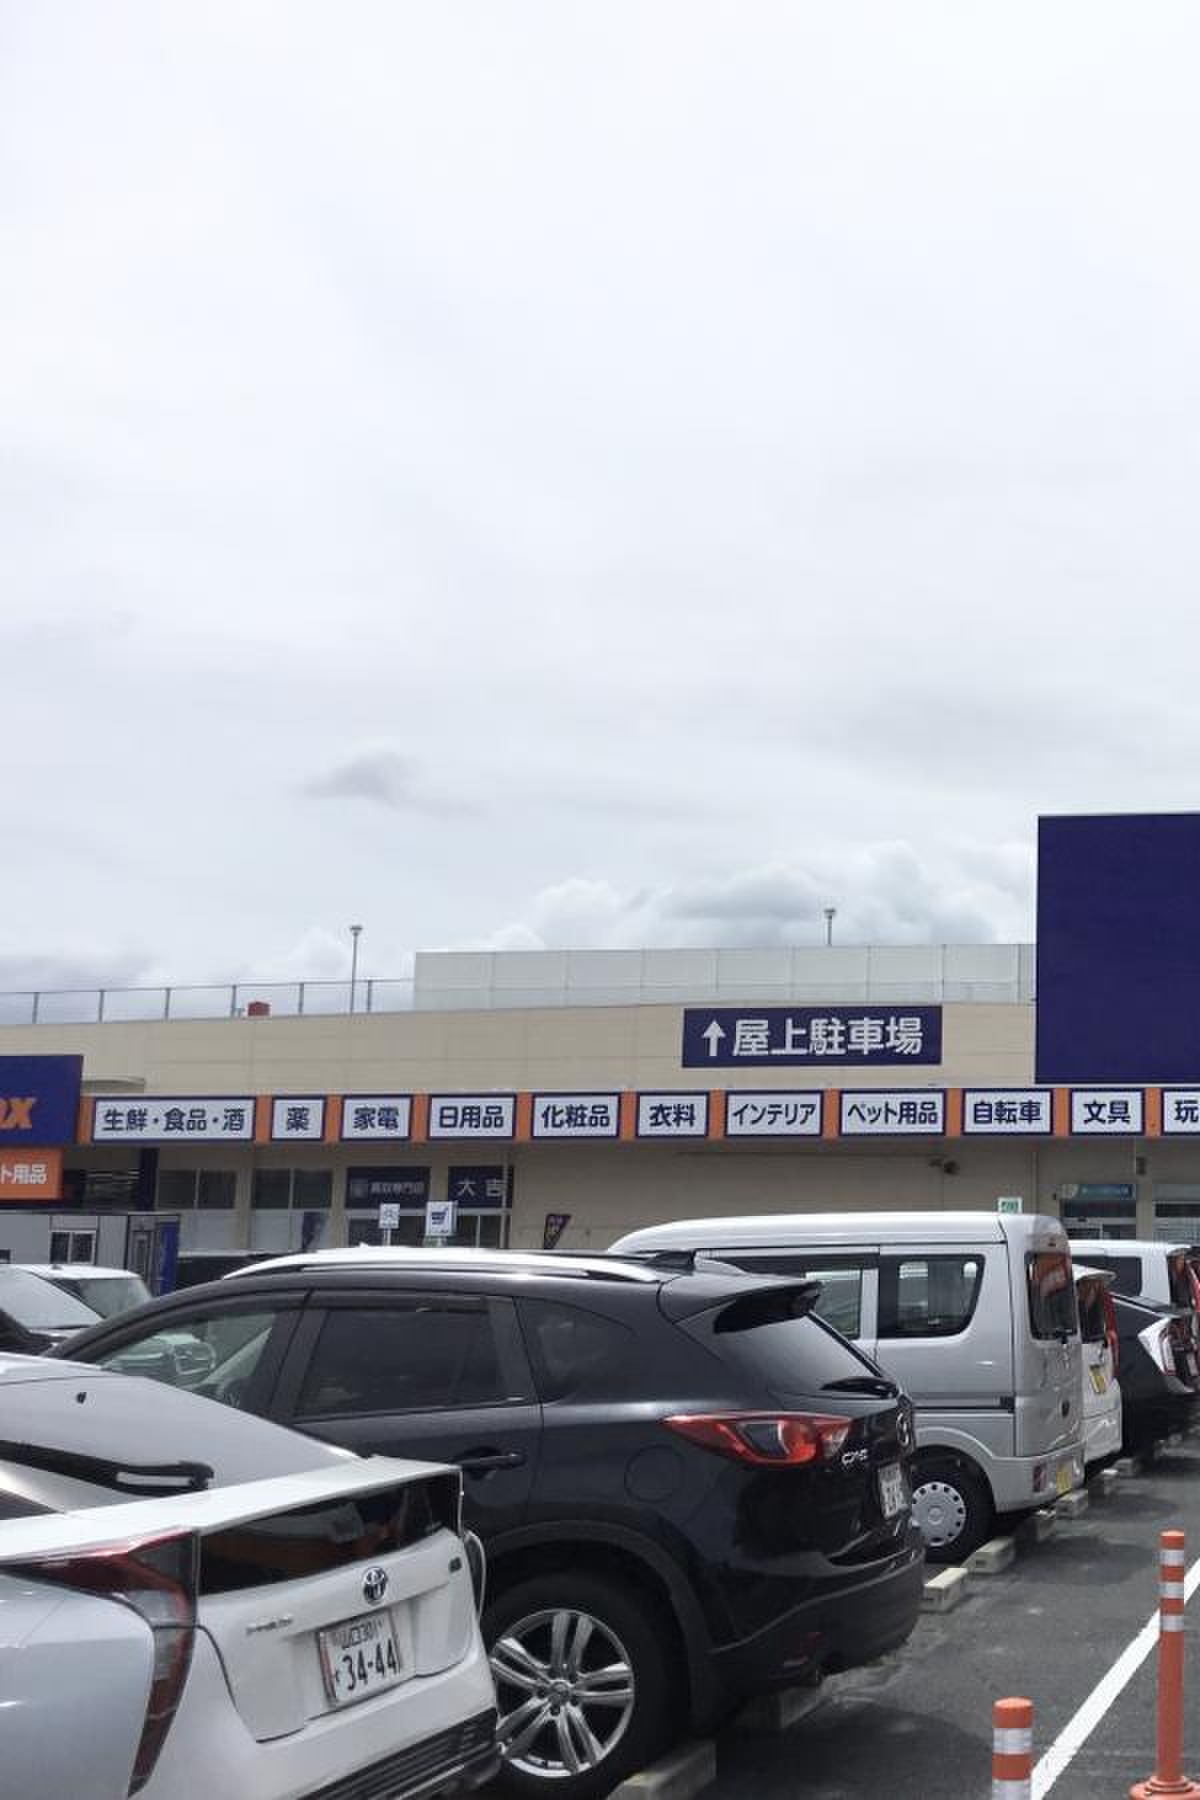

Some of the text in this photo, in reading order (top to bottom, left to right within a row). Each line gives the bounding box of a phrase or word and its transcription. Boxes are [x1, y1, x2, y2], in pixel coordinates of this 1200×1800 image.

[732, 1016, 924, 1057] 屋上駐車場
[102, 1107, 245, 1132] 生鮮・食品・酒
[286, 1106, 310, 1131] 薬
[353, 1106, 399, 1131] 家電
[438, 1105, 504, 1129] 日用品
[541, 1103, 610, 1128] 化粧品
[649, 1103, 696, 1128] 衣料
[732, 1103, 817, 1126] インテリア
[847, 1101, 938, 1125] ペット用品
[973, 1100, 1042, 1125] 自転車
[1083, 1100, 1131, 1125] 文具
